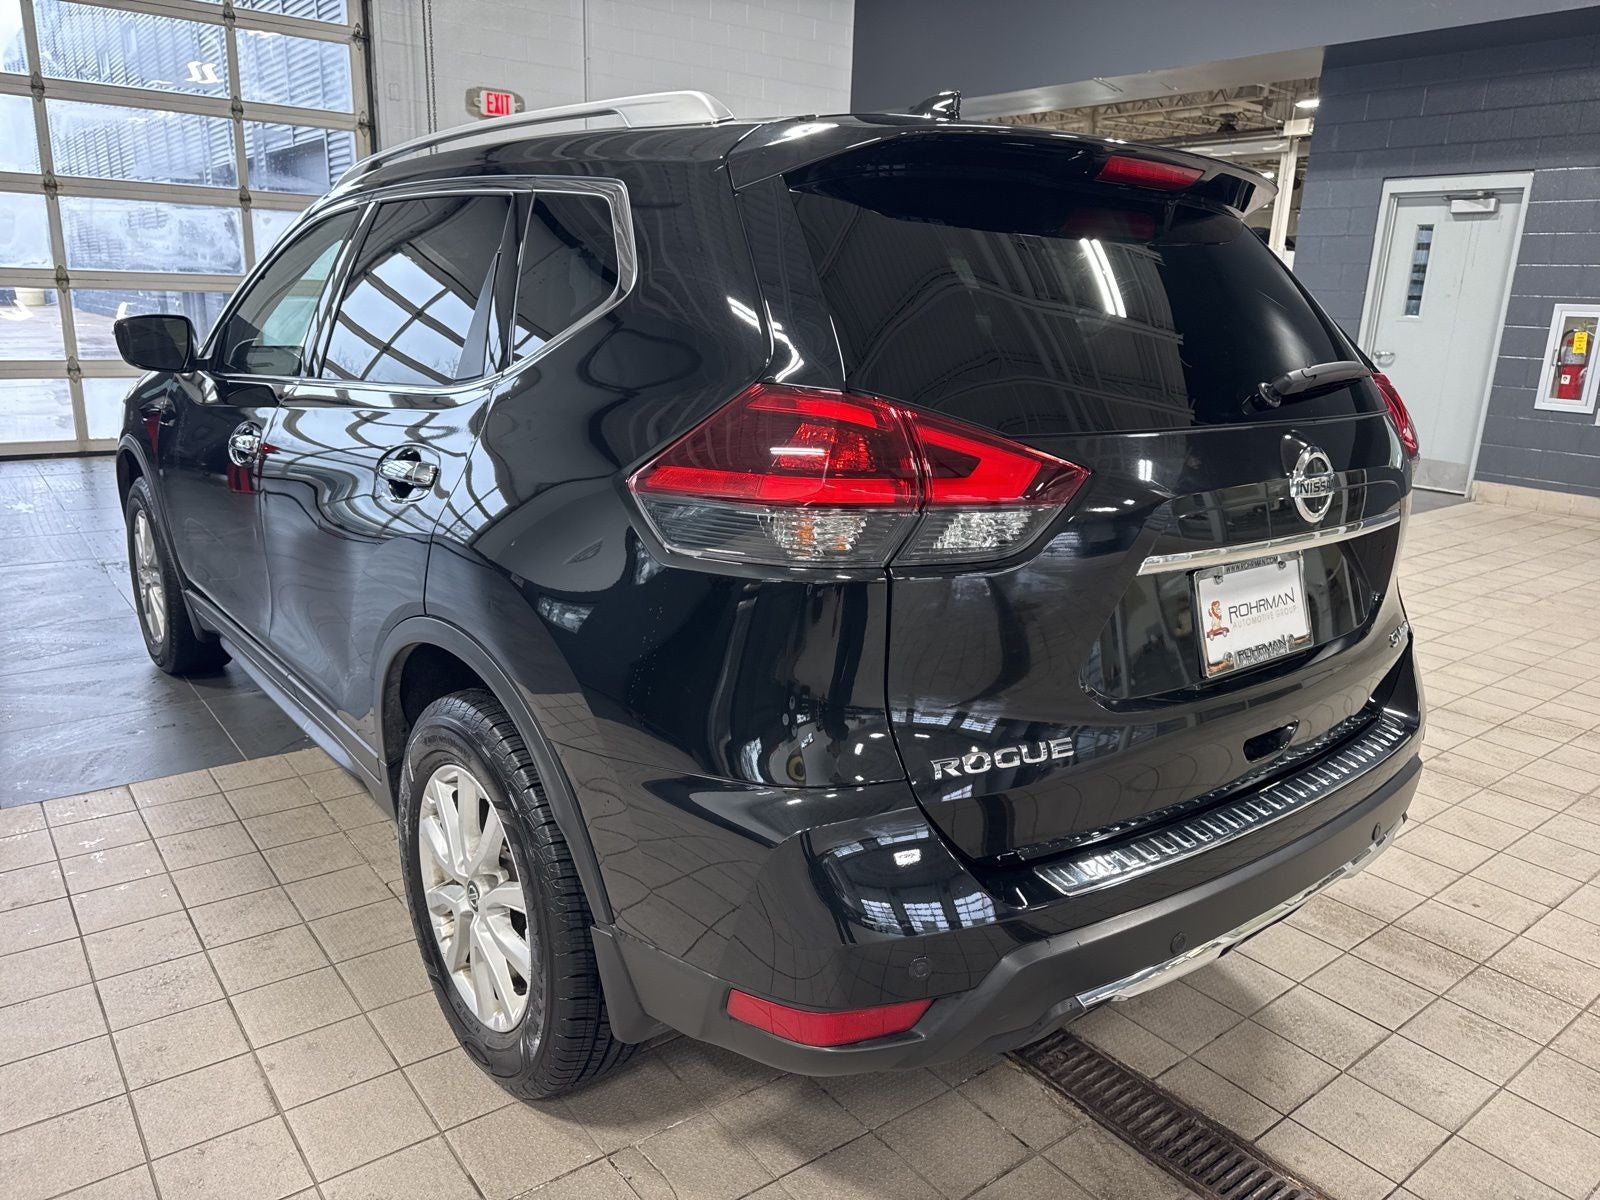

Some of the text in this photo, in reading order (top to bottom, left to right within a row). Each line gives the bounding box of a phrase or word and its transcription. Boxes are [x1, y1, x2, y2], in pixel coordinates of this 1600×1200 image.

[487, 92, 511, 115] EXIT
[1228, 586, 1295, 624] ROHRMAN
[1232, 604, 1297, 630] AUTOMOTIVE GROUP
[1237, 634, 1286, 663] ROHRMAN
[930, 737, 1075, 780] ROGUE
